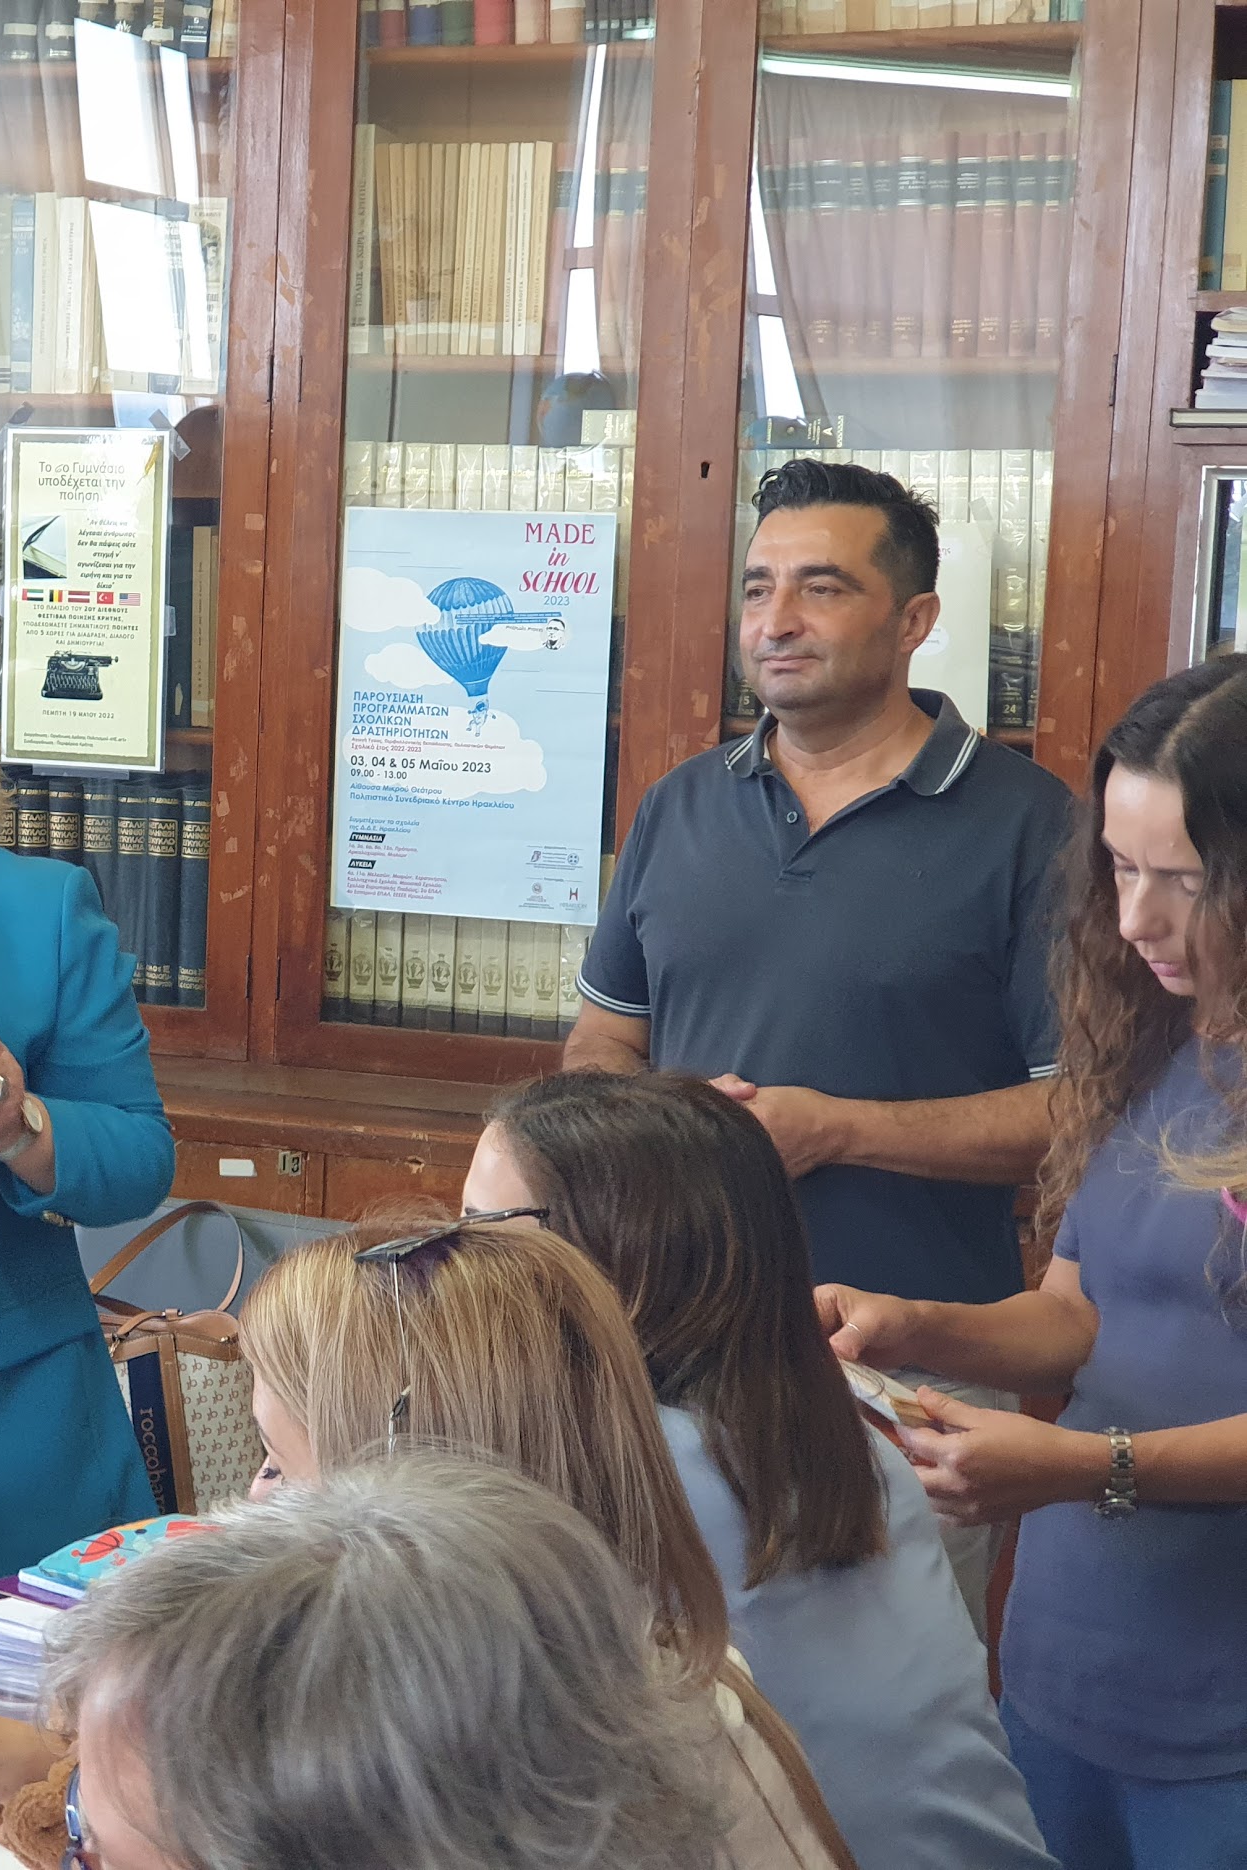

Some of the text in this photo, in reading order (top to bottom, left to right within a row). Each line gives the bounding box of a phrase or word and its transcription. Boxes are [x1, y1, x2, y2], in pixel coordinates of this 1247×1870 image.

[38, 462, 52, 472] Το
[72, 462, 125, 476] Γυμνάσιο
[38, 475, 126, 490] υποδέχεται την
[525, 522, 595, 544] MADE
[548, 547, 570, 566] in
[519, 570, 600, 594] SCHOOL
[544, 596, 570, 606] 2023
[354, 692, 423, 704] ΠΑΡΟΥΣΙΑΣΗ
[353, 702, 449, 716] ΠΡΟΓΡΑΜΜΑΤΩΝ
[1003, 704, 1016, 714] 24
[352, 714, 412, 726] ΣΧΟΛΙΚΩΝ
[352, 726, 448, 740] ΔΡΑΣΤΗΡΙΟΤΗΤΩΝ
[376, 744, 389, 752] έτος
[350, 756, 368, 768] 03,
[372, 756, 386, 767] 04
[390, 758, 396, 768] &
[402, 758, 416, 768] 05
[462, 762, 492, 773] 2023
[350, 768, 374, 778] 09.00
[384, 770, 407, 780] 13.00
[382, 784, 409, 792] Μικρού
[411, 786, 442, 795] Θεάτρου
[350, 792, 514, 809] Πολιτιστικό Συνεδριακό Κέντρο Ηρακλείου
[352, 834, 382, 842] ΓΥΜΝΑΣΙΑ
[282, 1153, 300, 1173] 13
